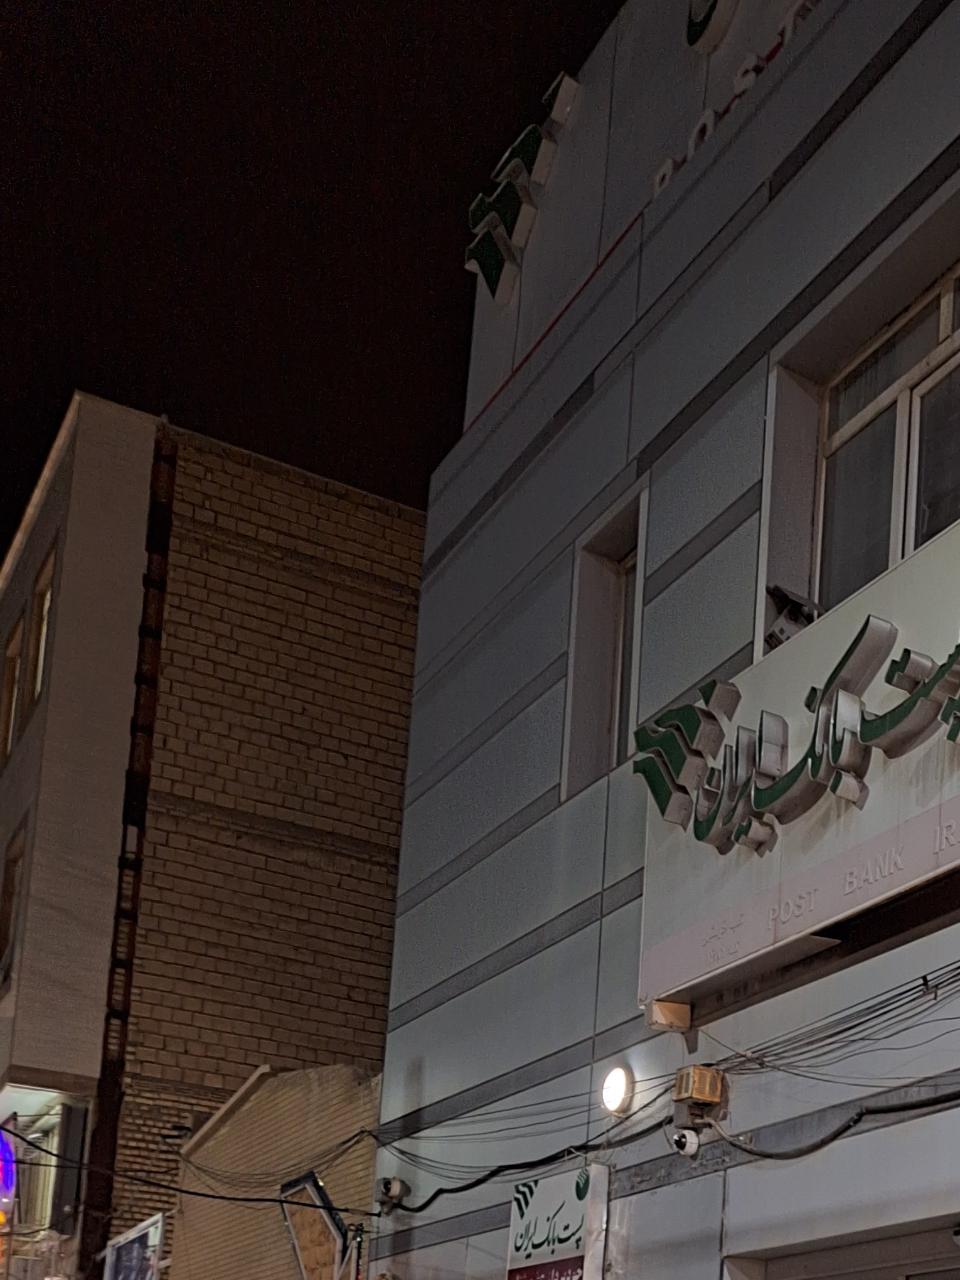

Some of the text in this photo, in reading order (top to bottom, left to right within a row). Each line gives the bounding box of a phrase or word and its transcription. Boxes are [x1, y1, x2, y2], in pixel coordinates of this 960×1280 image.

[767, 888, 820, 930] POST
[843, 844, 905, 896] BANK
[532, 1200, 566, 1255] بانک
[557, 1213, 585, 1250] پست
